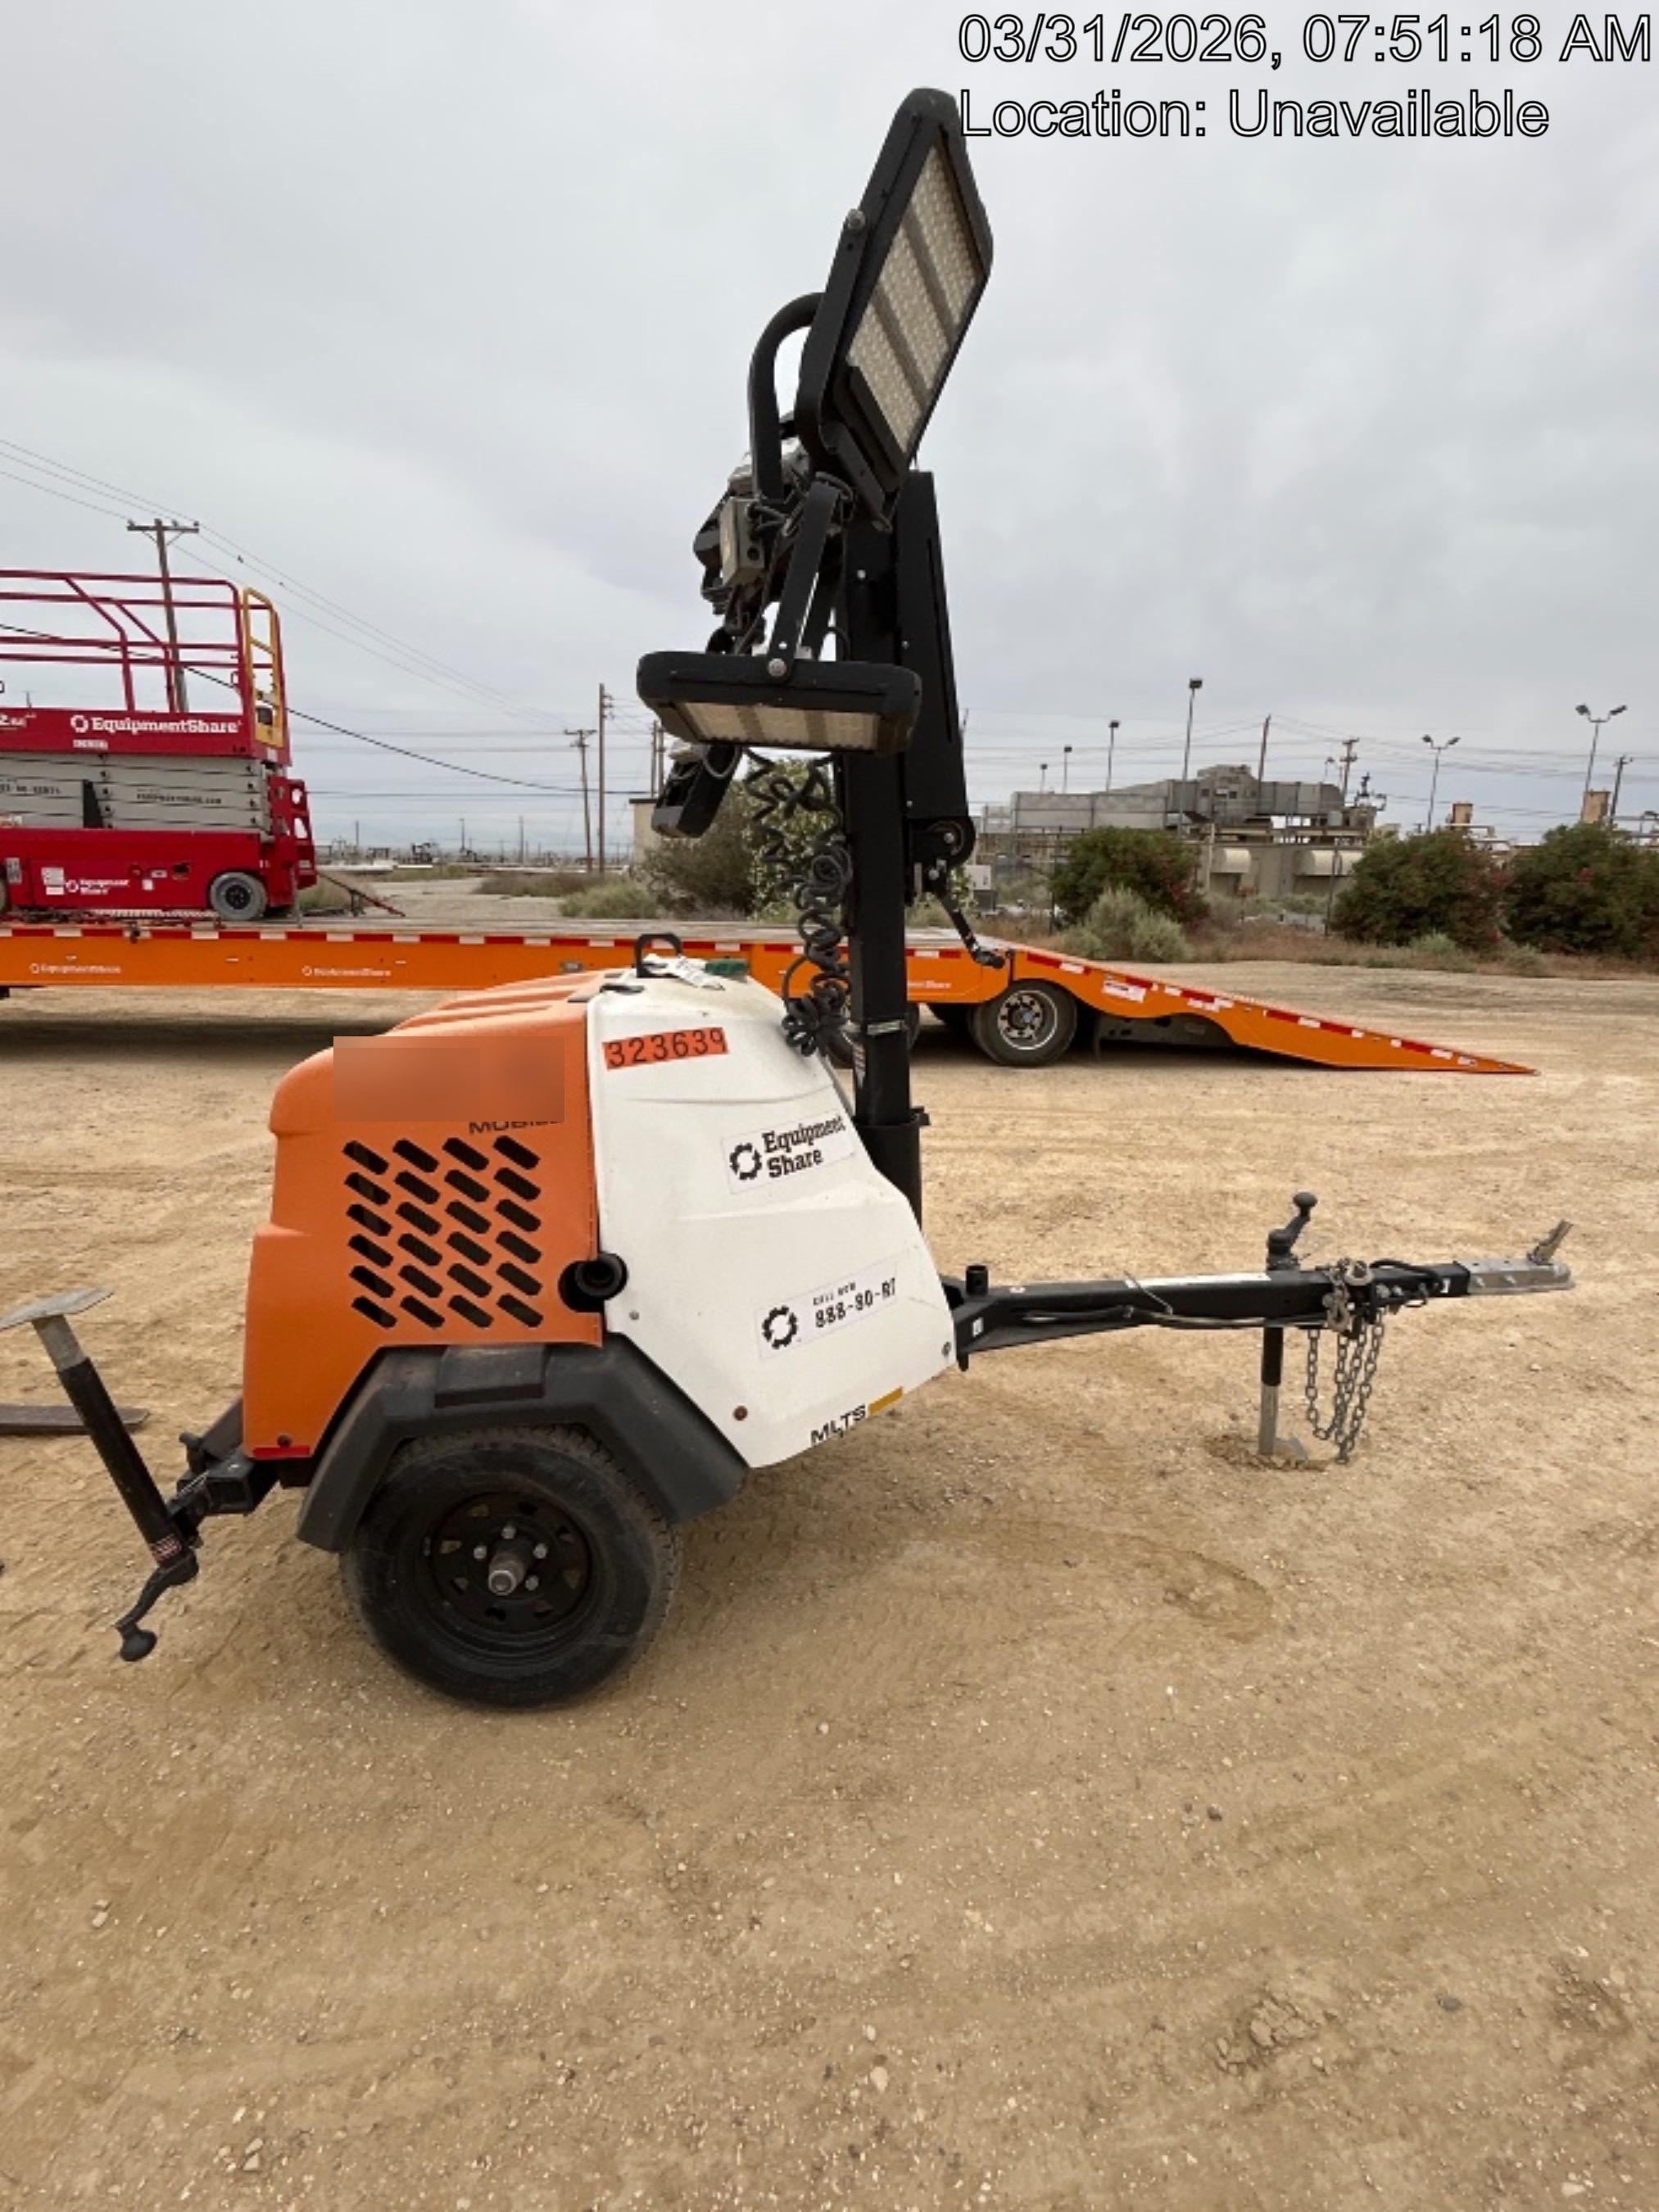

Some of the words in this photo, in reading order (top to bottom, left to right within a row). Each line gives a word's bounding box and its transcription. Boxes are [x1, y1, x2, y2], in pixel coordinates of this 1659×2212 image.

[91, 716, 238, 735] EquipmentShare
[608, 1027, 728, 1067] 323639
[762, 1114, 846, 1153] Equipment
[767, 1149, 824, 1178] Share
[810, 1403, 866, 1444] MLTS
